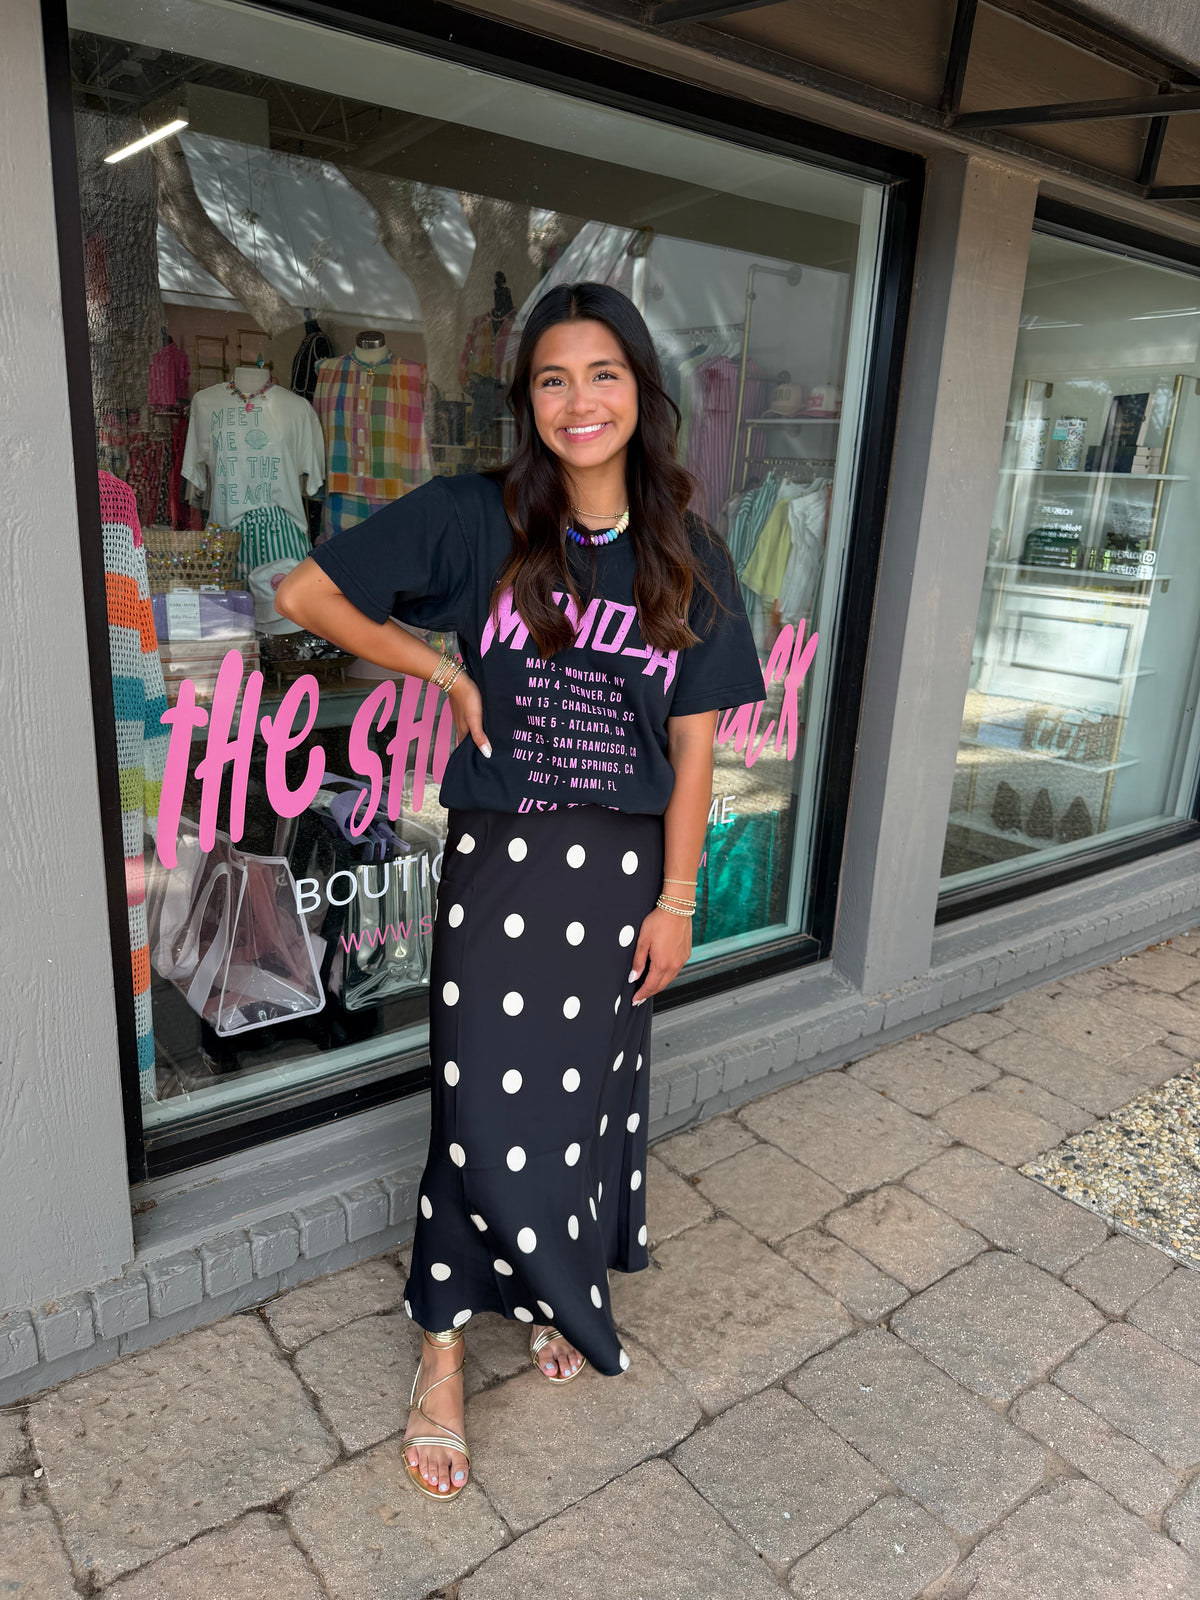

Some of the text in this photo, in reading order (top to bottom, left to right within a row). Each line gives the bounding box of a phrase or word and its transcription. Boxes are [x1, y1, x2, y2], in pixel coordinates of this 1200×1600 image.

[211, 407, 263, 431] MEET
[212, 432, 237, 452] ME
[217, 456, 281, 481] AT THE
[218, 482, 272, 505] BEACH
[526, 658, 547, 670] MAY
[550, 662, 556, 672] 2
[565, 667, 611, 684] MONTAUK,
[614, 676, 625, 688] NY
[528, 677, 551, 689] MAY
[554, 680, 561, 691] 4
[570, 684, 606, 702] DENVER,
[609, 691, 622, 703] CO
[515, 695, 533, 707] MAY
[537, 697, 549, 708] 15
[561, 699, 619, 720] CHARLESTON,
[622, 711, 635, 722] SC
[527, 715, 546, 728] JUNE
[550, 717, 557, 728] 5
[568, 719, 613, 735] ATLANTA,
[615, 726, 625, 737] GA
[512, 729, 533, 743] JUNE
[535, 733, 545, 745] 25
[552, 737, 573, 749] SAN
[576, 739, 628, 756] FRANCISCO,
[629, 746, 637, 758] CA
[512, 748, 534, 762] JULY
[536, 752, 543, 763] 2
[552, 756, 577, 769] PALM
[581, 759, 621, 774] SPRINGS,
[624, 763, 634, 775] CA
[527, 770, 551, 785] JULY
[553, 775, 559, 786] 7
[570, 777, 605, 790] MIAMI,
[608, 780, 617, 791] FL
